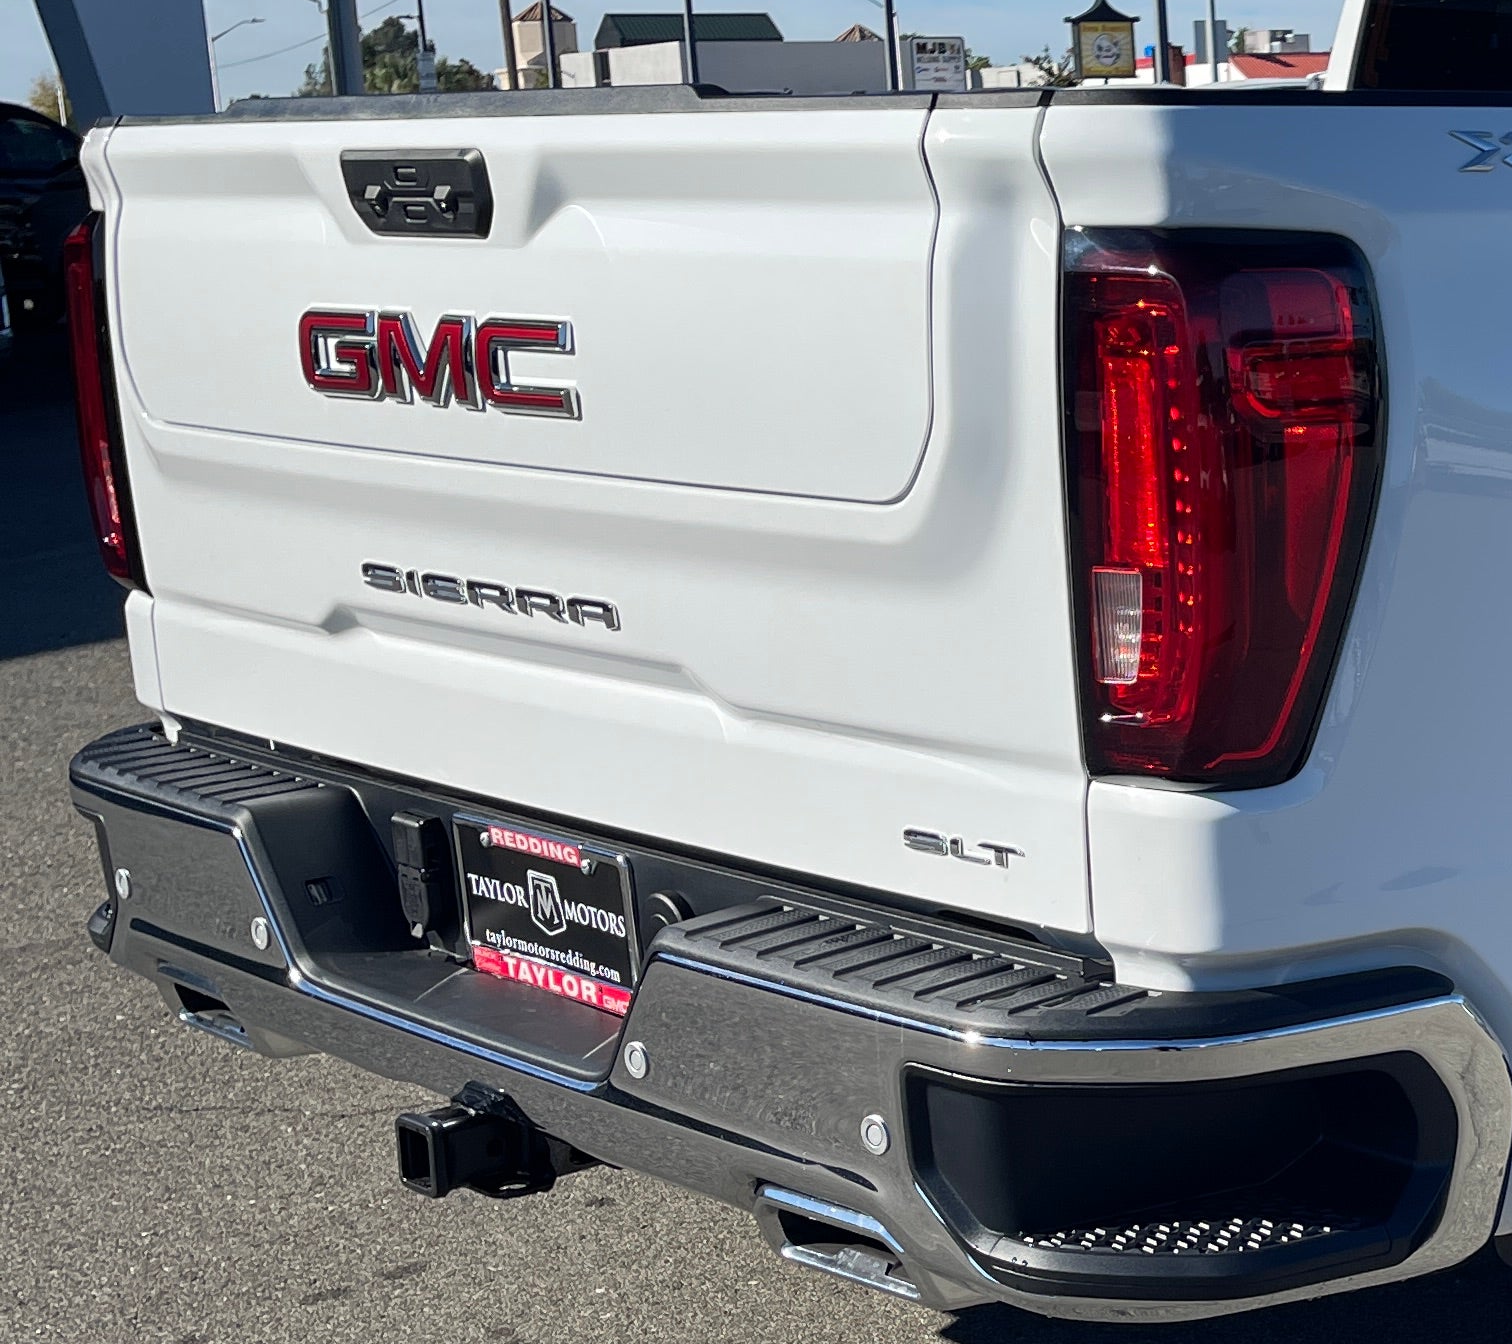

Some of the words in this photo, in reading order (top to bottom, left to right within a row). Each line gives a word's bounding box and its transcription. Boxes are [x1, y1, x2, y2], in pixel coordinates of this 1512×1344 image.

[299, 307, 583, 421] GMC
[361, 562, 622, 631] SIERRA
[490, 828, 578, 865] REDDING
[903, 828, 1025, 869] SLT
[467, 873, 529, 909] TAYLOR
[564, 899, 626, 938] MOTORS
[486, 928, 620, 983] taylormotorsredding.com
[503, 957, 597, 1004] TAYLOR
[603, 996, 630, 1014] GMC
